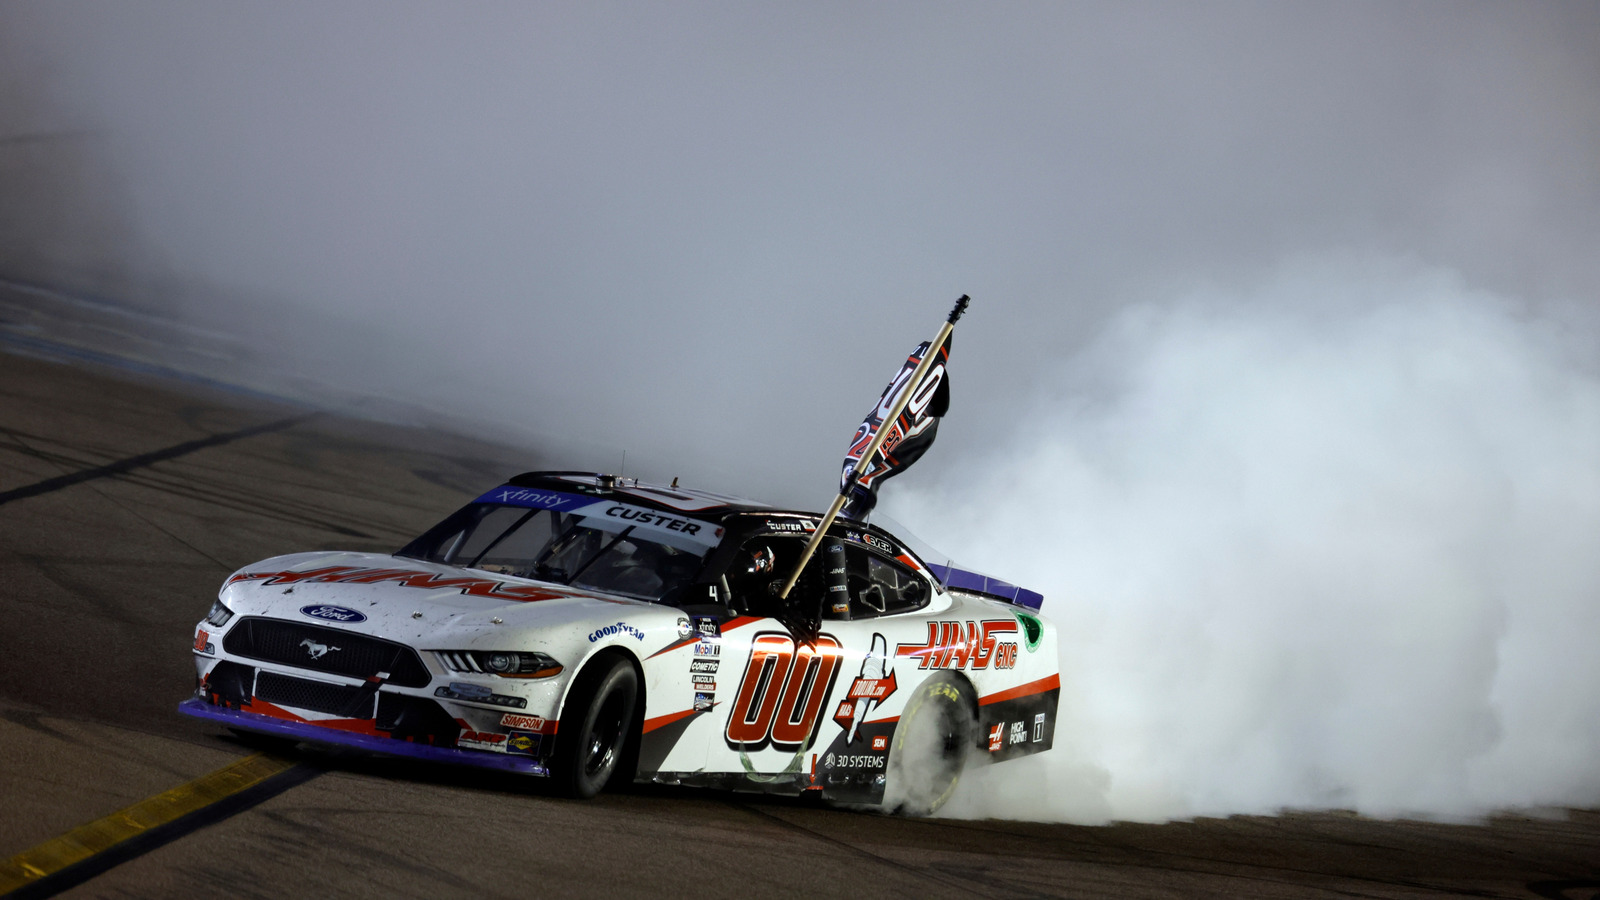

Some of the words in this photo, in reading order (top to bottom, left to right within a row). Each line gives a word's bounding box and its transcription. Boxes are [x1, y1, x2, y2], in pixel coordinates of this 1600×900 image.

[497, 489, 571, 508] xfinity
[605, 506, 702, 536] CUSTER
[862, 533, 893, 554] 4EVER
[228, 566, 610, 603] HAAS
[709, 585, 718, 602] 4
[310, 605, 351, 621] Ford
[588, 622, 645, 643] GOODYEAR
[694, 644, 713, 654] Mobil
[714, 645, 720, 655] 1
[894, 619, 1018, 670] HAAS
[994, 642, 1018, 669] CNC
[691, 662, 719, 671] COMETIC
[725, 631, 844, 753] 00
[838, 704, 853, 717] HAAS
[502, 715, 543, 729] SIMPSON
[1010, 721, 1024, 733] HIGH
[460, 731, 507, 743] ARP
[873, 738, 885, 748] SEM
[837, 755, 849, 767] 3D
[850, 756, 884, 768] SYSTEMS
